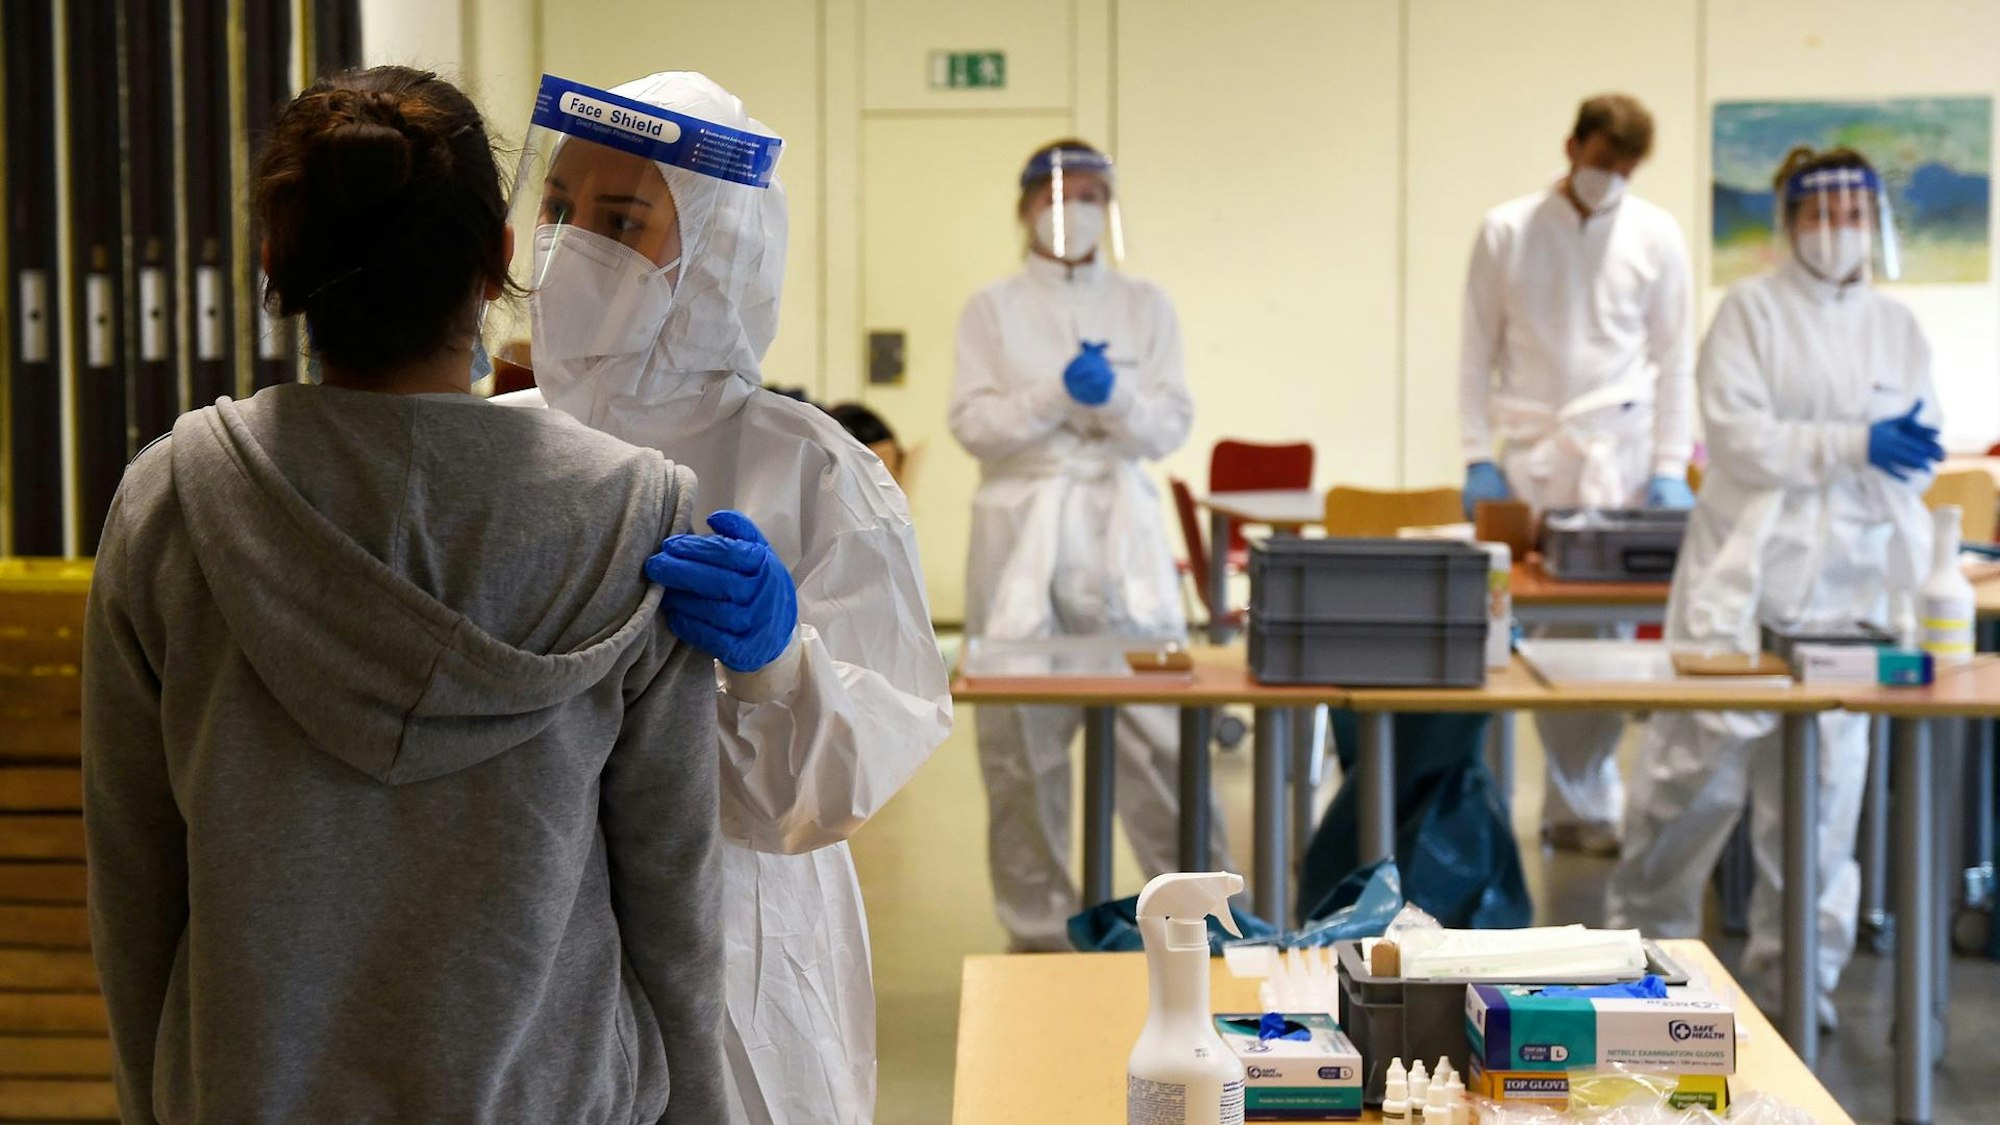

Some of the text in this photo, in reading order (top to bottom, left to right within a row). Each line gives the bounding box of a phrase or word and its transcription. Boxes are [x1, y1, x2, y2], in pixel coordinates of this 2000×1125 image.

[570, 98, 602, 118] Face
[610, 110, 663, 136] Shield
[1692, 1032, 1725, 1040] HEALTH
[1556, 1050, 1563, 1058] L
[1607, 1049, 1725, 1058] NITRILE EXAMINATION GLOVES
[1505, 1080, 1568, 1089] TOP GLOVE
